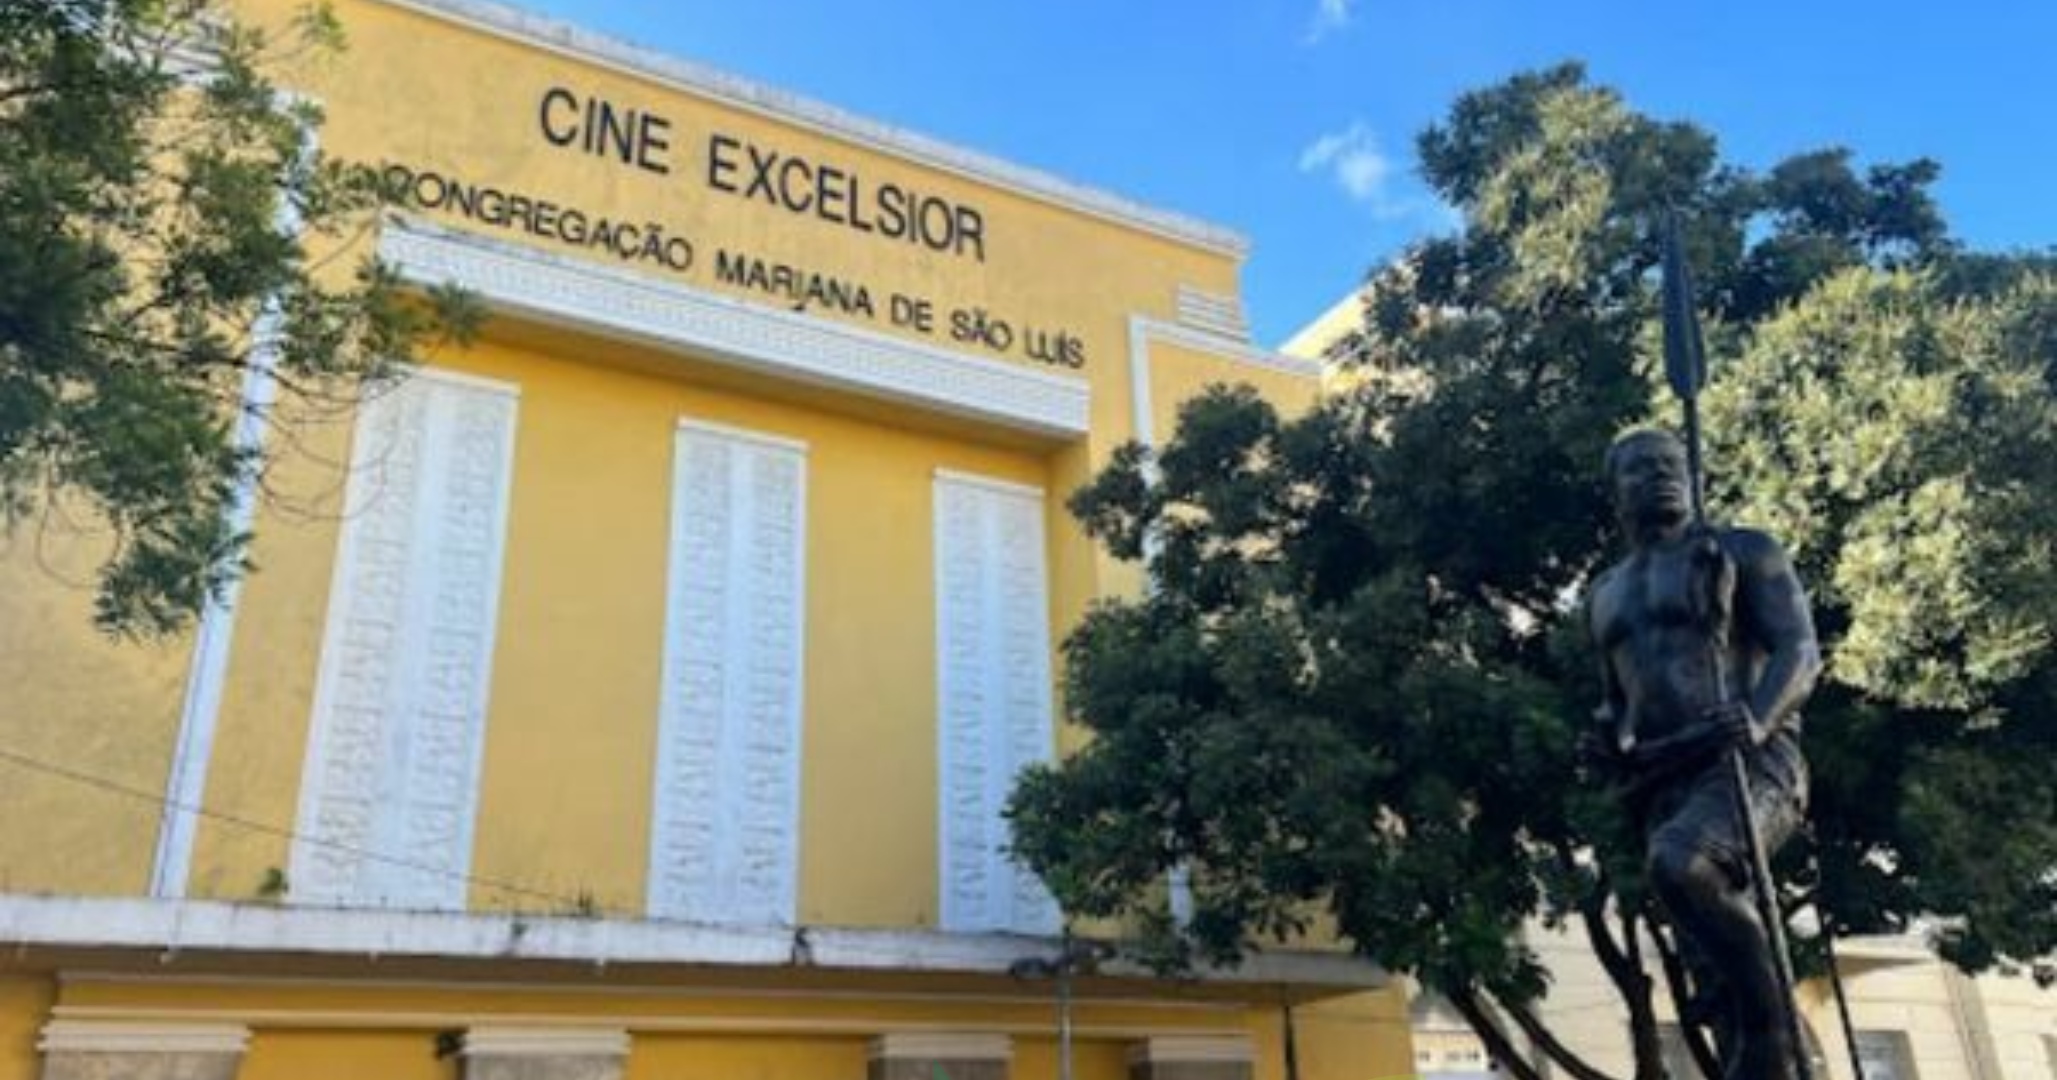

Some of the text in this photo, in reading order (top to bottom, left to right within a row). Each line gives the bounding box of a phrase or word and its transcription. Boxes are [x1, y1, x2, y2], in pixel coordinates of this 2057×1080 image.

[540, 87, 985, 261] CINE EXCELSIOR
[715, 248, 874, 318] MARIANA
[890, 294, 933, 333] DE
[950, 308, 1014, 350] SÃO
